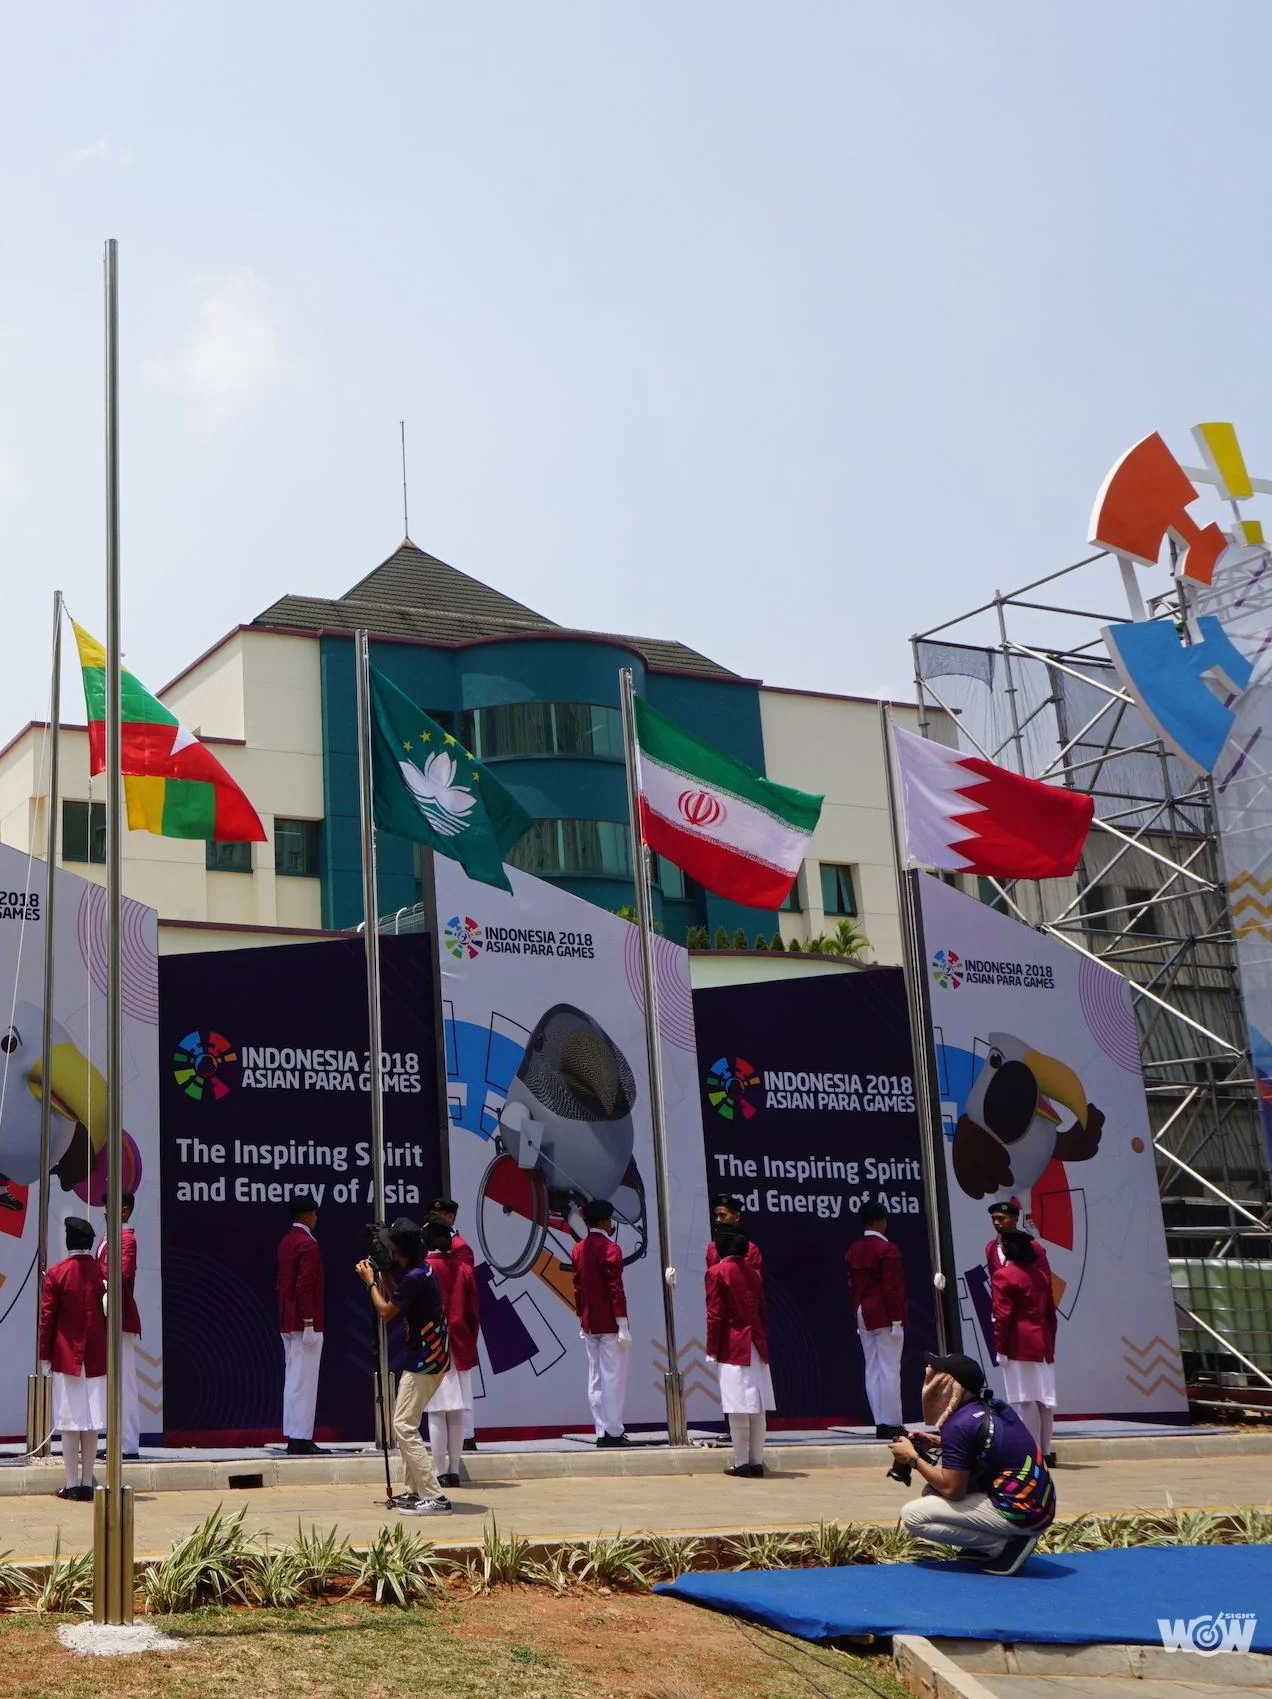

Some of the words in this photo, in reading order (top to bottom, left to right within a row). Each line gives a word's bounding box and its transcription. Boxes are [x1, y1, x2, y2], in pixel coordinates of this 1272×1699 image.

[485, 927, 556, 944] INDONESIA
[559, 931, 593, 947] 2018
[486, 941, 521, 955] ASIAN
[523, 943, 554, 956] PARA
[556, 945, 595, 959] GAMES
[964, 959, 1023, 976] INDONESIA
[1025, 964, 1053, 978] 2018
[966, 972, 995, 985] ASIAN
[997, 974, 1022, 987] PARA
[1024, 976, 1055, 989] GAMES
[241, 1046, 359, 1072] INDONESIA
[241, 1069, 300, 1089] ASIAN
[304, 1071, 356, 1091] PARA
[358, 1073, 422, 1093] GMES
[763, 1070, 864, 1094] INDONESIA
[866, 1075, 913, 1095] 2018
[765, 1091, 816, 1109] ASIAN
[818, 1093, 862, 1111] PARA
[863, 1095, 916, 1113] GAMES
[175, 1138, 226, 1163] The
[234, 1139, 348, 1172] Inspiring
[355, 1141, 424, 1167] Sirit
[714, 1153, 758, 1177] The
[763, 1155, 860, 1185] Inspiring
[864, 1157, 921, 1185] Spirit
[176, 1176, 226, 1202] and
[333, 1178, 359, 1203] of
[731, 1189, 760, 1212] nd
[766, 1189, 843, 1218] Energy
